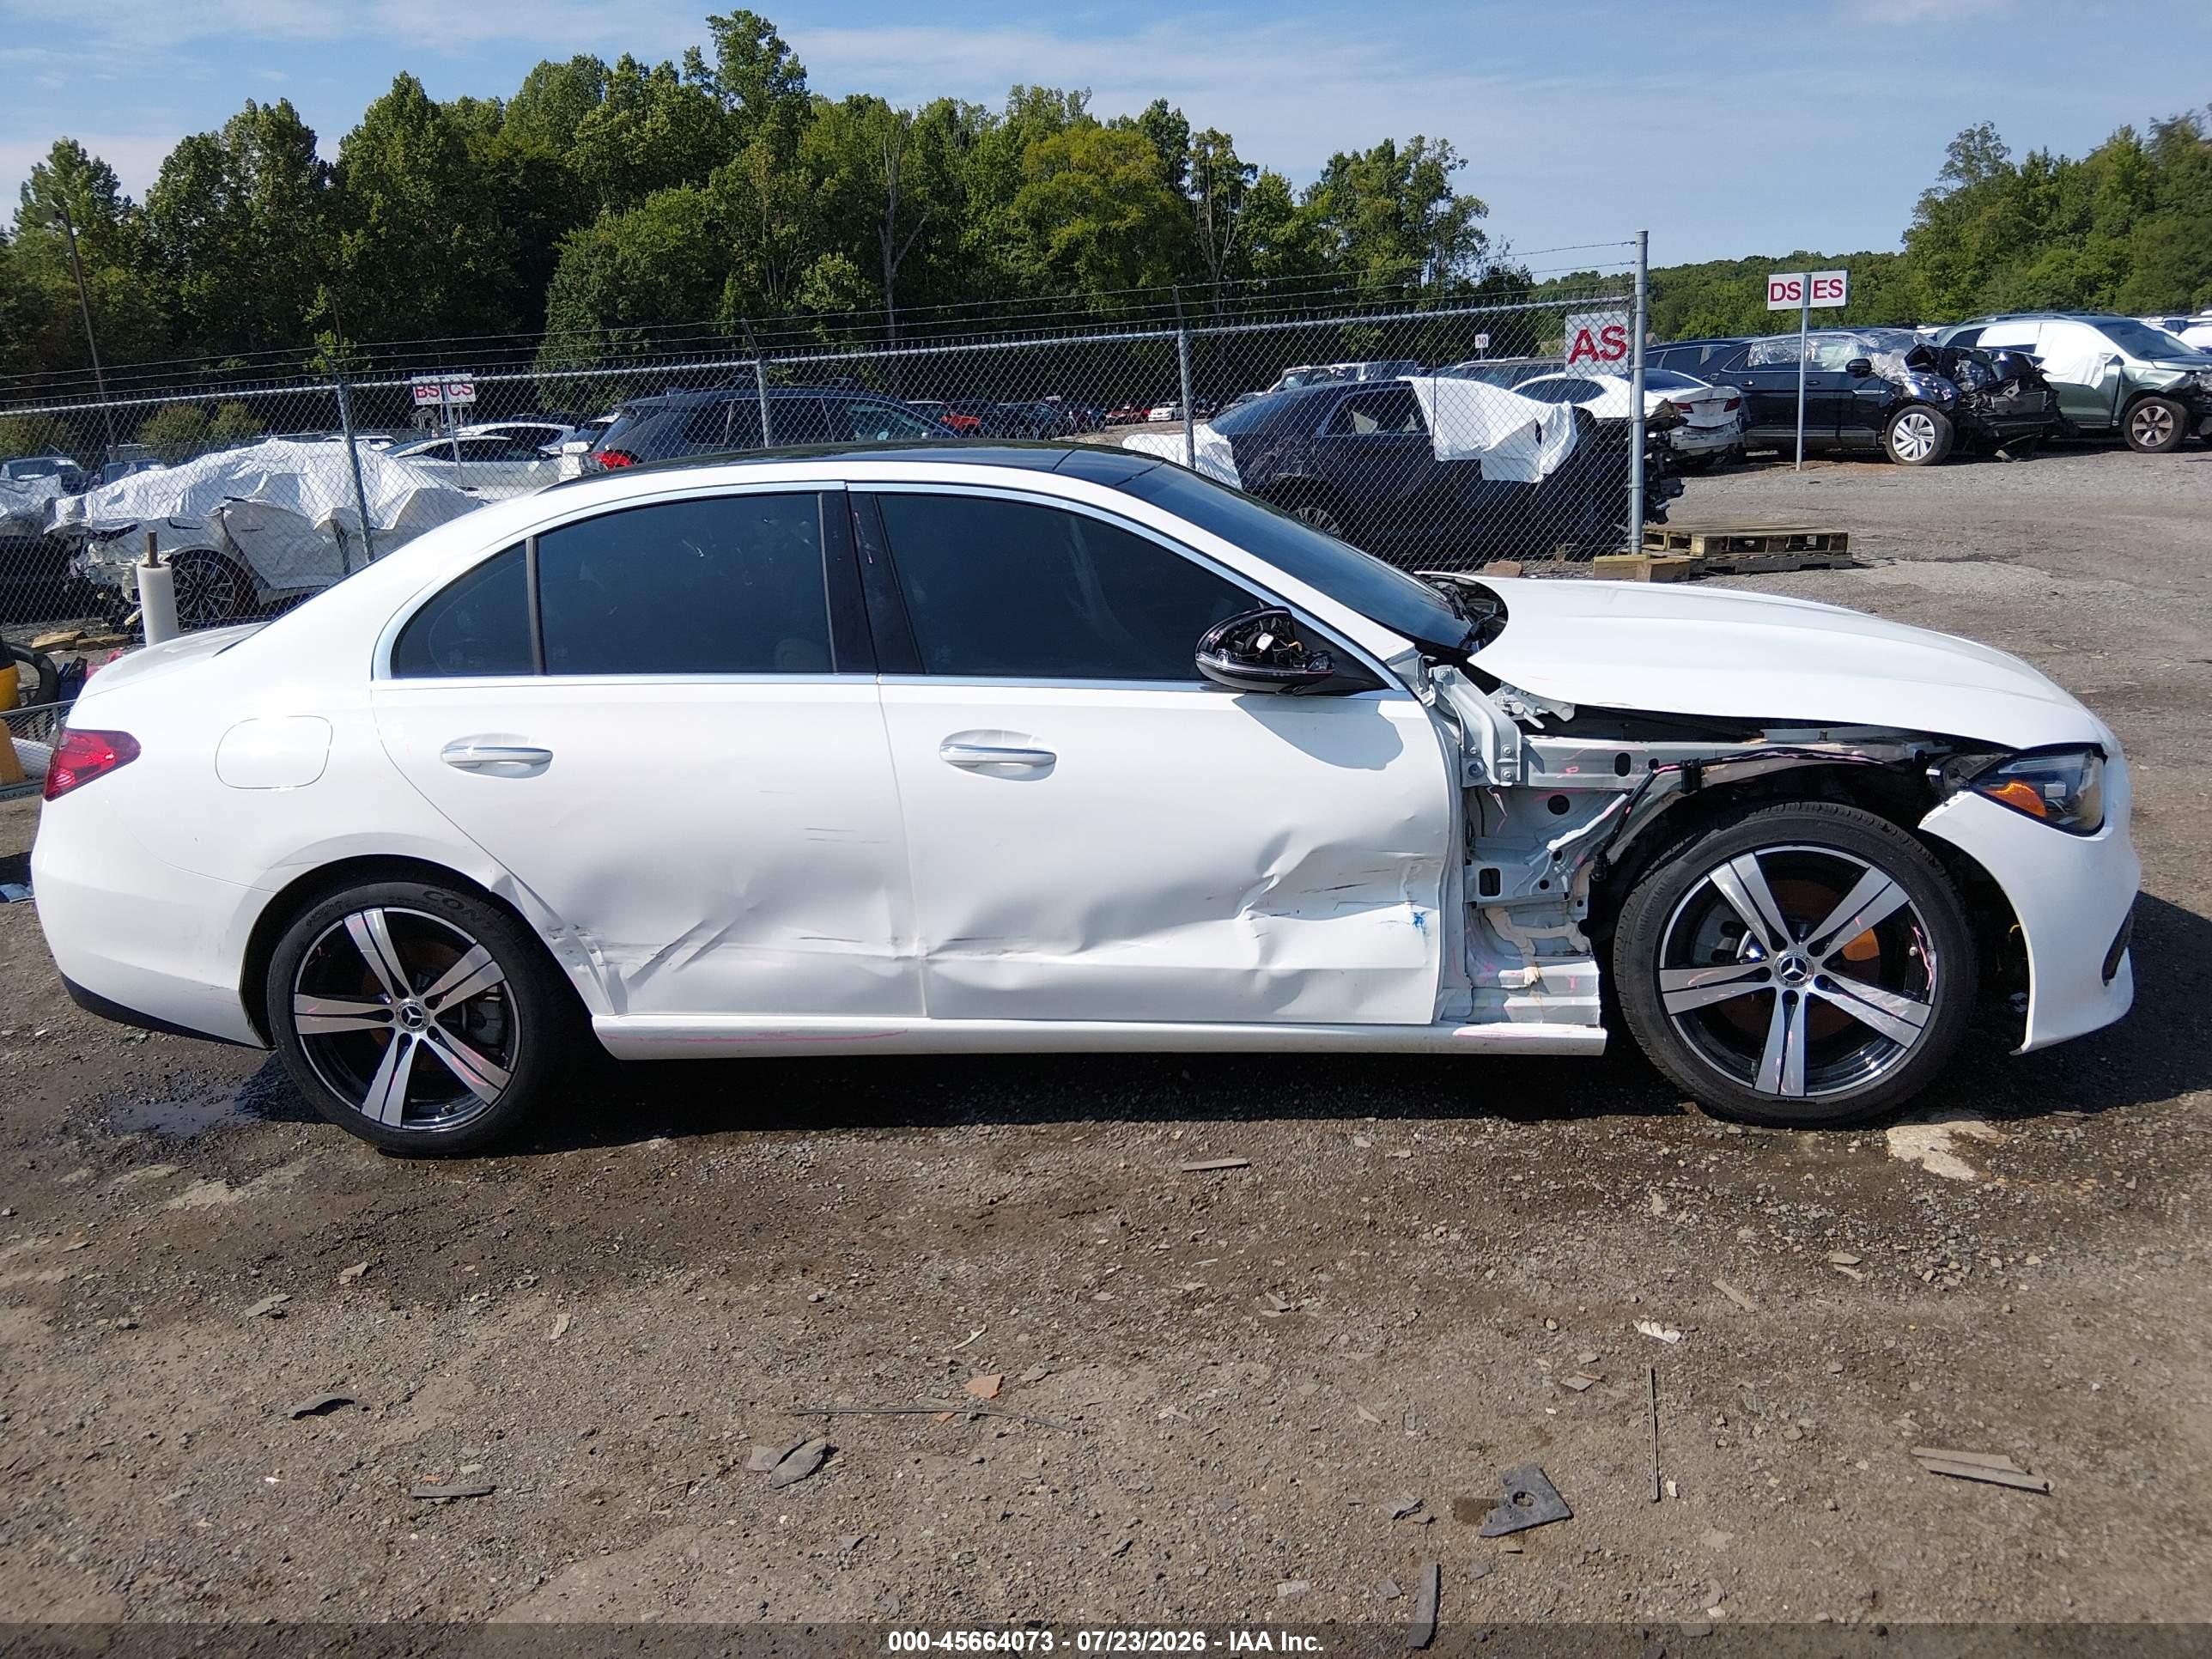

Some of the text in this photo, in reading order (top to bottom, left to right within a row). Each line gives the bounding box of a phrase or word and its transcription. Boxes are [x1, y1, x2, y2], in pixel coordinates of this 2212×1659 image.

[1770, 281, 1802, 302] DS
[1813, 278, 1844, 300] ES
[1477, 337, 1487, 347] 10
[1568, 325, 1627, 365] AS
[415, 383, 440, 398] BS
[447, 381, 473, 397] CS
